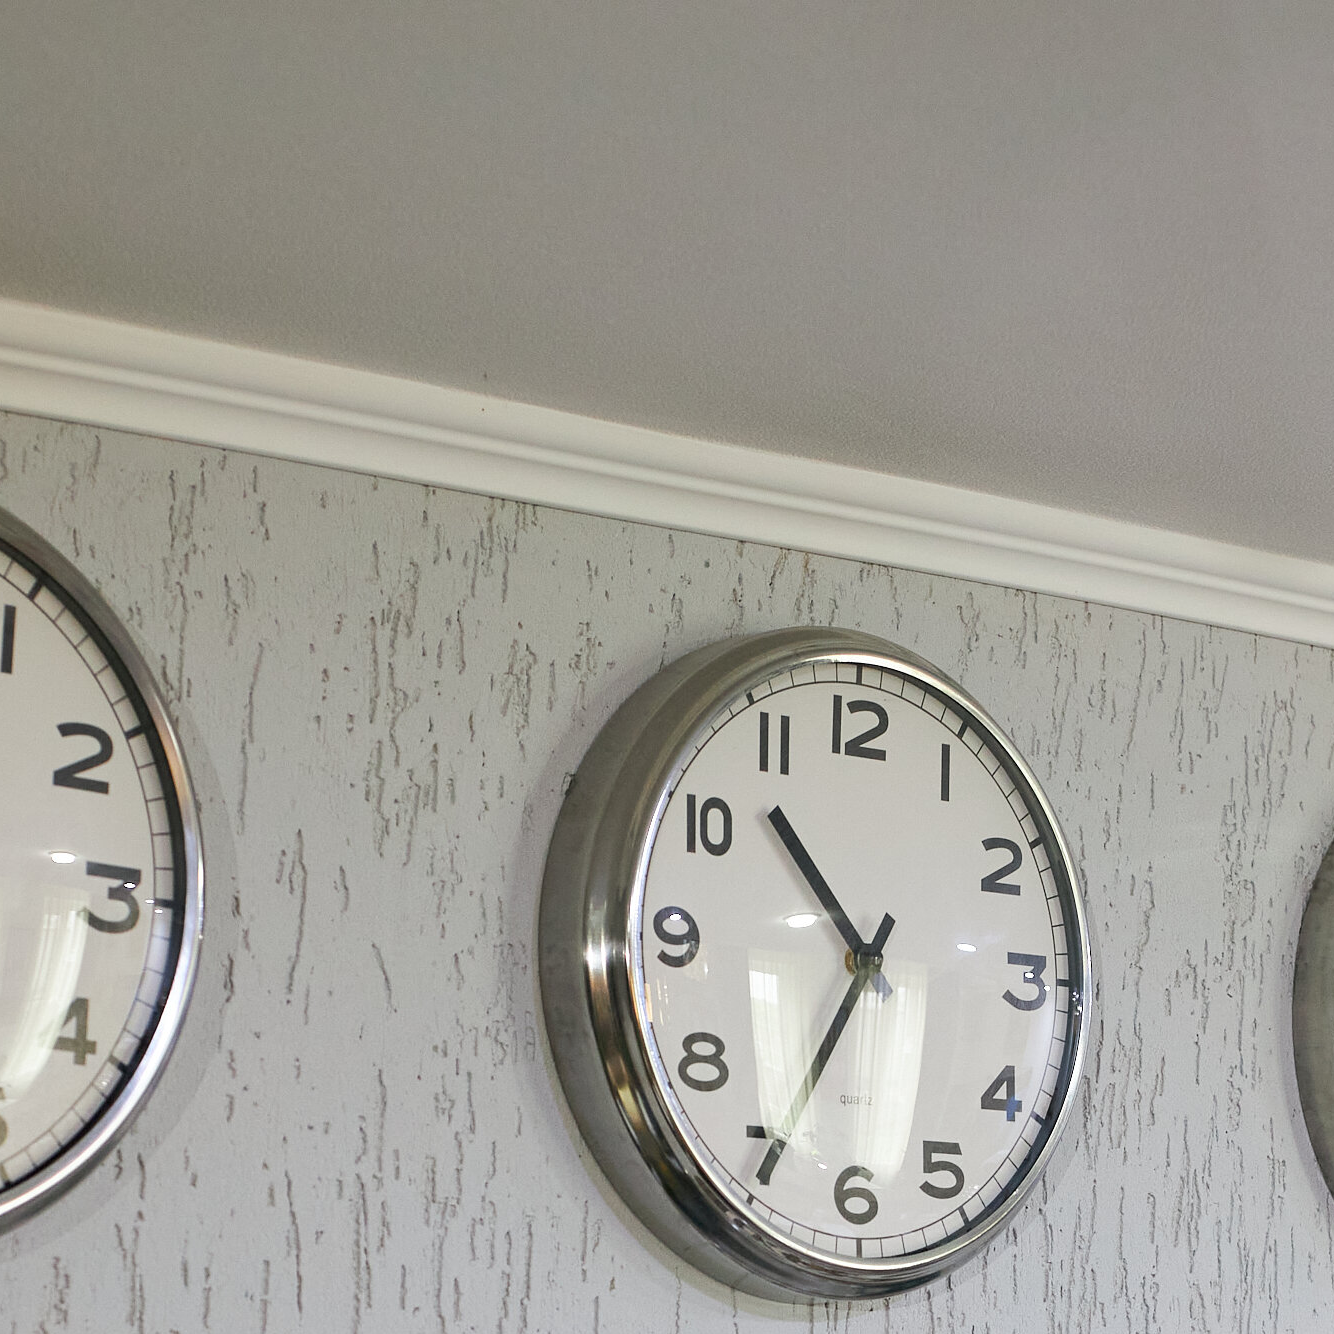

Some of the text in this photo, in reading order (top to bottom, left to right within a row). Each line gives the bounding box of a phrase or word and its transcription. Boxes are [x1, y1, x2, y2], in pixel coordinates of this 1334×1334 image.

[0, 605, 15, 673] 1
[759, 712, 789, 775] 11
[832, 695, 889, 761] 12
[53, 723, 113, 794] 2
[941, 744, 950, 801] 1
[686, 794, 732, 855] 10
[981, 838, 1021, 895] 2
[85, 862, 141, 934] 3
[653, 906, 699, 967] 9
[1002, 952, 1046, 1010] 3
[39, 998, 96, 1065] 4
[678, 1032, 729, 1091] 8
[840, 1093, 872, 1106] quartz
[981, 1065, 1022, 1122] 4
[747, 1125, 785, 1185] 7
[919, 1140, 964, 1198] 5
[834, 1165, 878, 1225] 6
